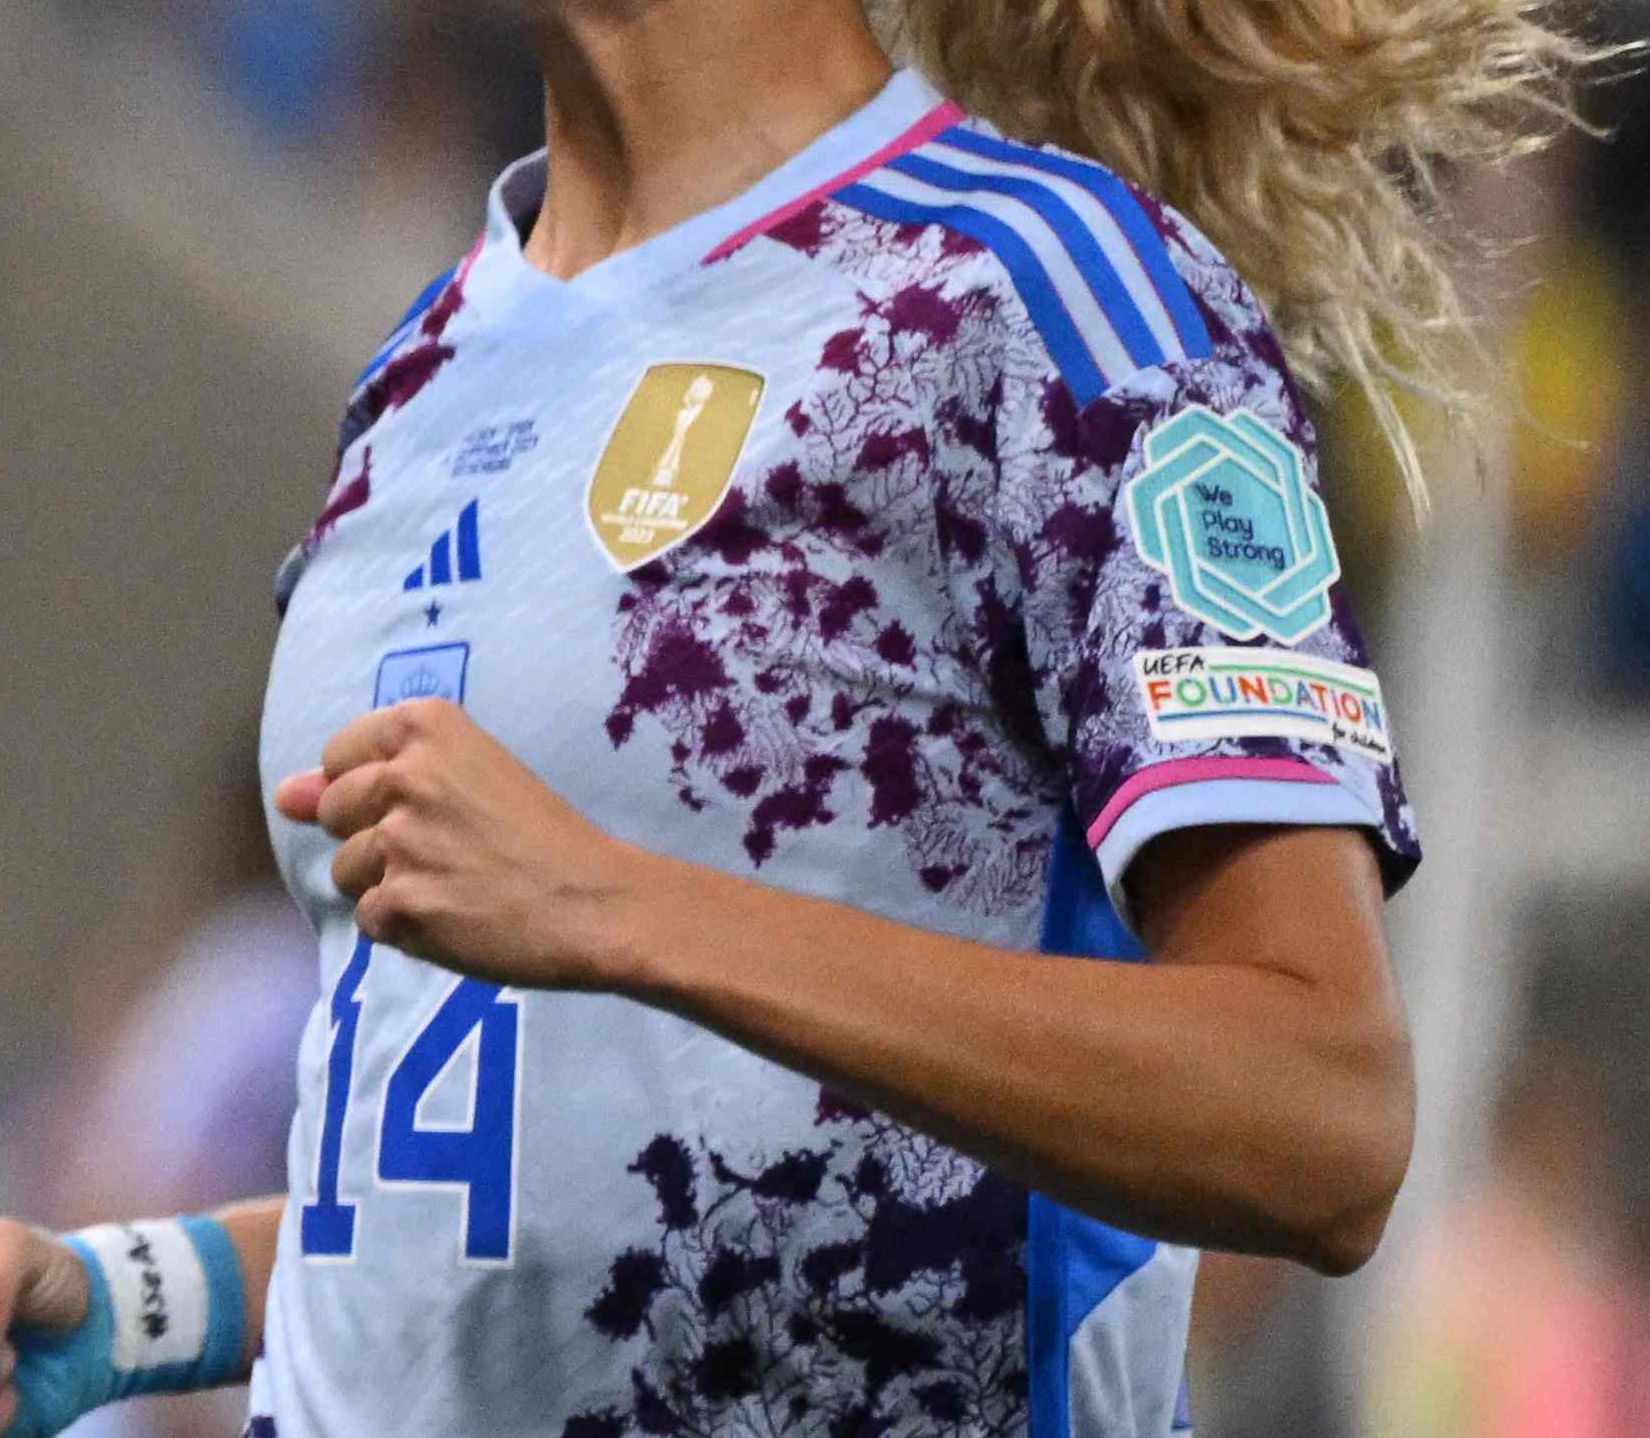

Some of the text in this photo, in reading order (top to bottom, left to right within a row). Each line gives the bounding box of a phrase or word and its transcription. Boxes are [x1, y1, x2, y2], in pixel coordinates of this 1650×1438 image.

[617, 488, 681, 518] FIFA
[1194, 481, 1233, 507] We
[1202, 508, 1254, 542] Play
[1207, 536, 1286, 572] Strong
[1143, 653, 1205, 675] UEFA
[1146, 675, 1384, 731] FOUNDATION
[298, 930, 524, 1269] 14
